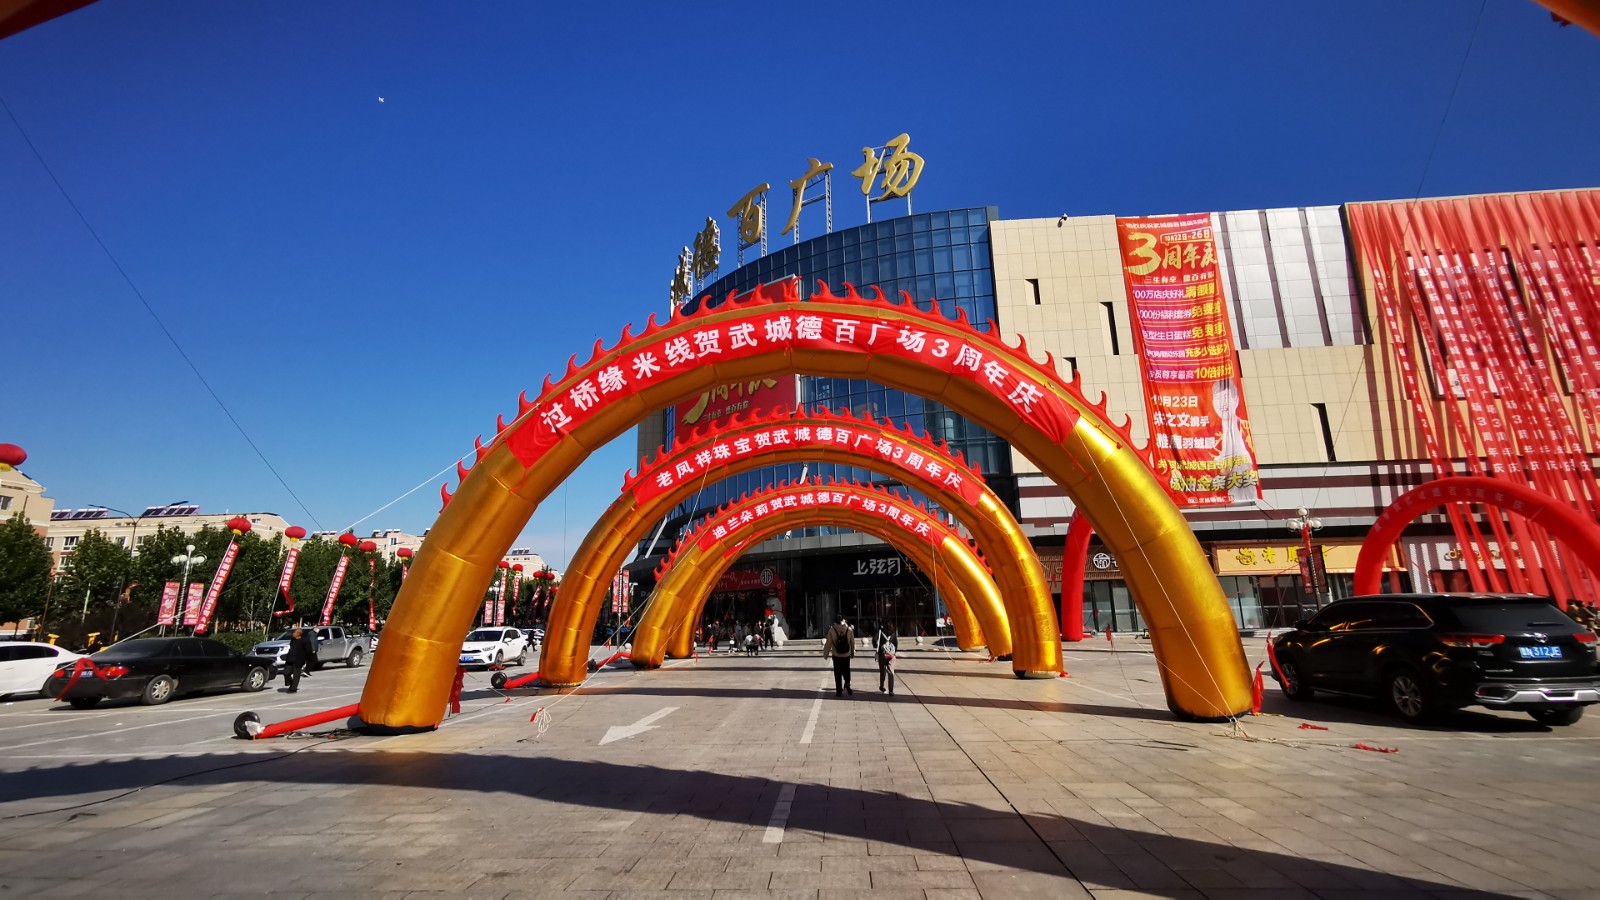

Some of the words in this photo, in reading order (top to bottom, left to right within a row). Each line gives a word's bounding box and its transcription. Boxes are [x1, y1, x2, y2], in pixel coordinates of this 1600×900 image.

[1128, 232, 1217, 276] 3周年庆
[1133, 283, 1214, 299] 00万店庆好礼满额
[539, 313, 1045, 434] 过桥缘米线贺武城德百广场3周年庆
[1152, 395, 1198, 407] 10月23日
[656, 427, 963, 489] 老凤祥珠宝贺武城德百广场3周年庆
[712, 491, 932, 540] 迪兰朵莉贺武城德百广场3周年庆
